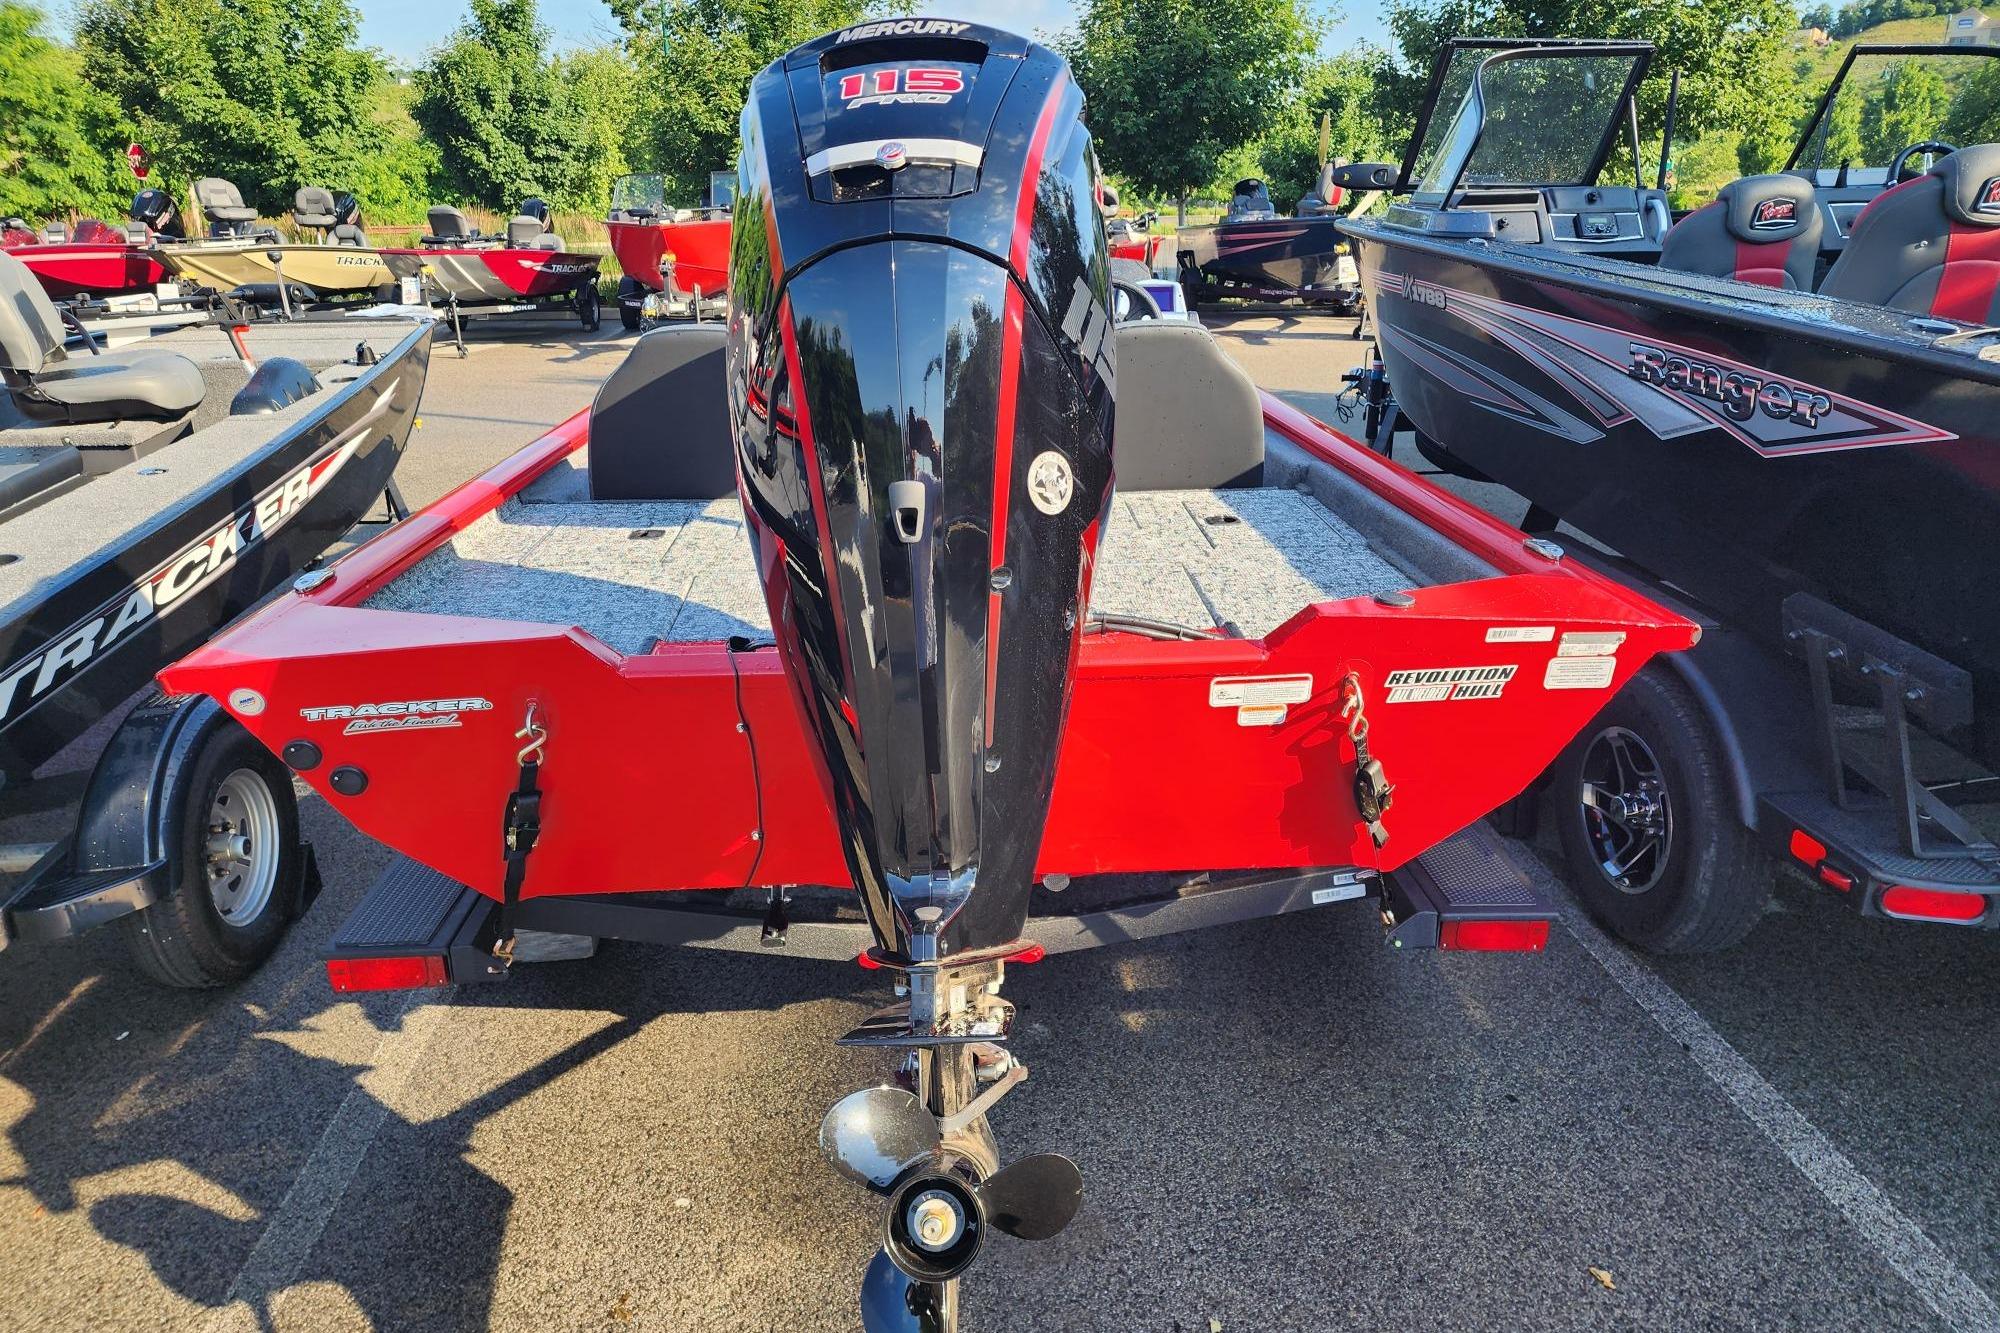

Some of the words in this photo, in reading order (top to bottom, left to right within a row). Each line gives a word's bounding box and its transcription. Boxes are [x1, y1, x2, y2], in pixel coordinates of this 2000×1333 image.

[835, 20, 971, 45] MERCURY
[840, 68, 964, 100] 115
[846, 93, 953, 110] PRO
[551, 264, 588, 274] TRACKER
[497, 304, 537, 313] TRACKER
[1628, 341, 1833, 430] Ranger
[0, 465, 315, 724] TRACKER
[1387, 666, 1515, 685] REVOLUTION
[1453, 683, 1502, 698] HULL
[301, 698, 485, 721] TRACKER
[348, 720, 377, 731] Fish
[380, 719, 400, 729] the
